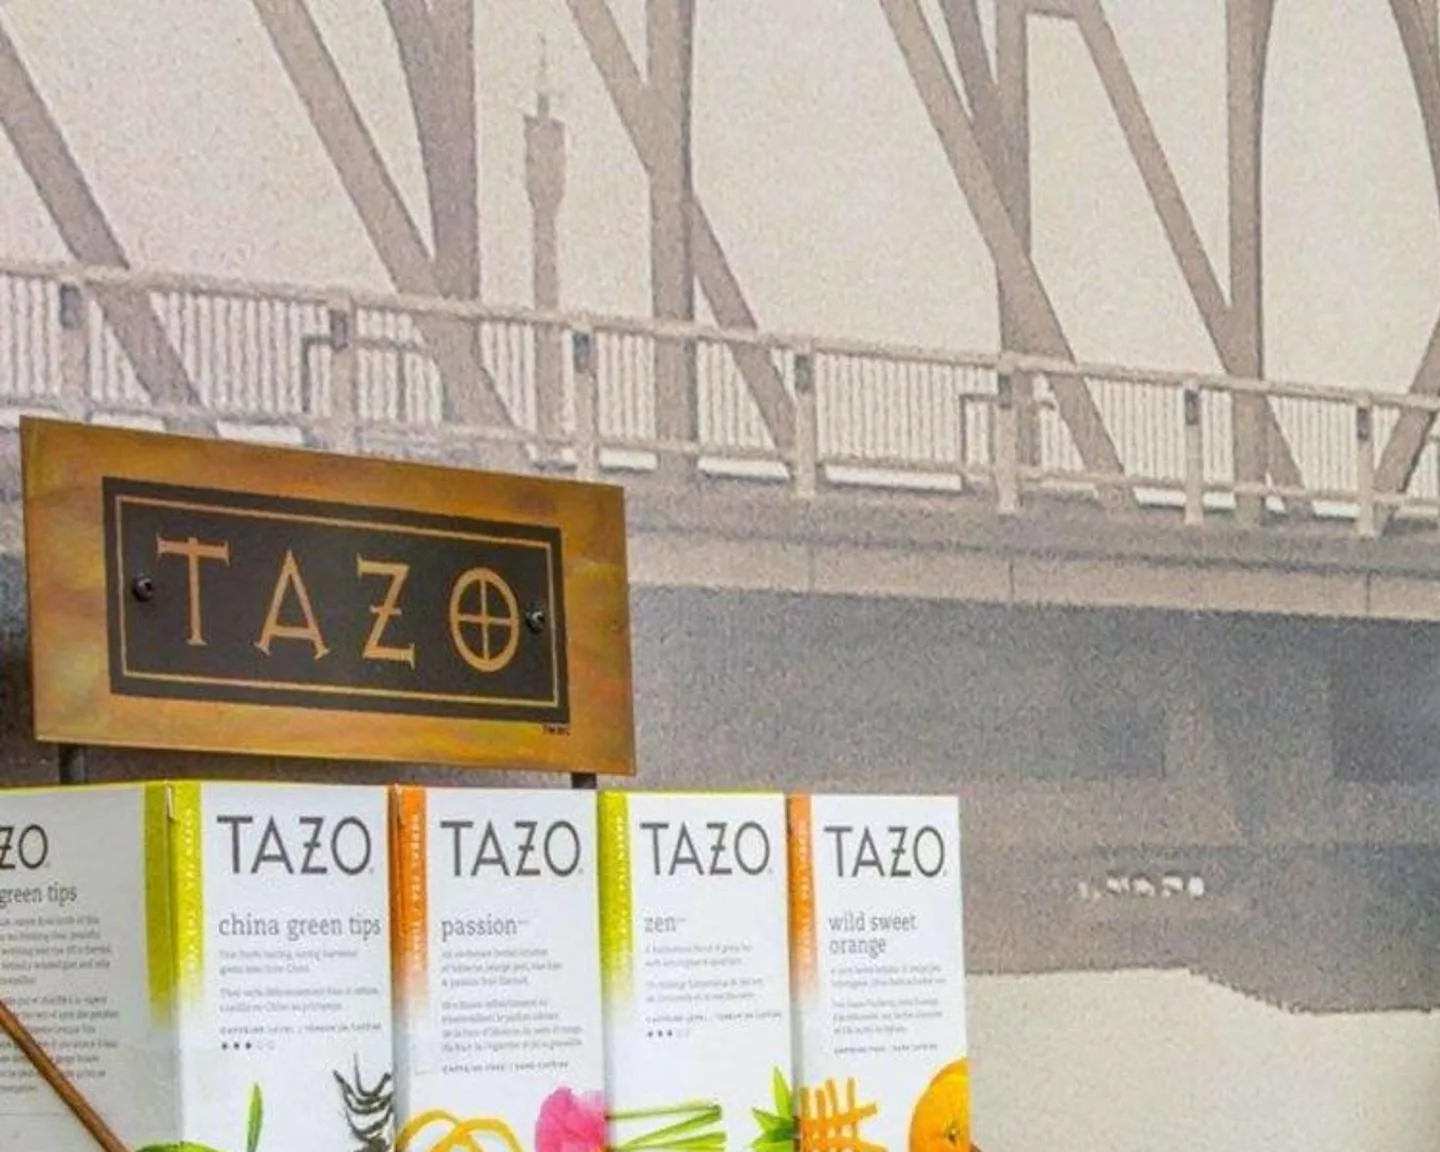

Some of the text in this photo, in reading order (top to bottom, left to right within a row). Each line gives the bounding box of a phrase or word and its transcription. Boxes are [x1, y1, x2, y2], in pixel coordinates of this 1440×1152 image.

[156, 537, 519, 673] TAZO
[216, 815, 372, 876] TAZO
[440, 820, 581, 877] TAZO
[640, 822, 770, 876] TAZO
[824, 826, 945, 877] TAZO
[47, 881, 78, 908] tips
[218, 912, 382, 942] china green tips
[441, 914, 518, 942] passion
[828, 910, 918, 933] wild sweet
[829, 938, 887, 959] orange
